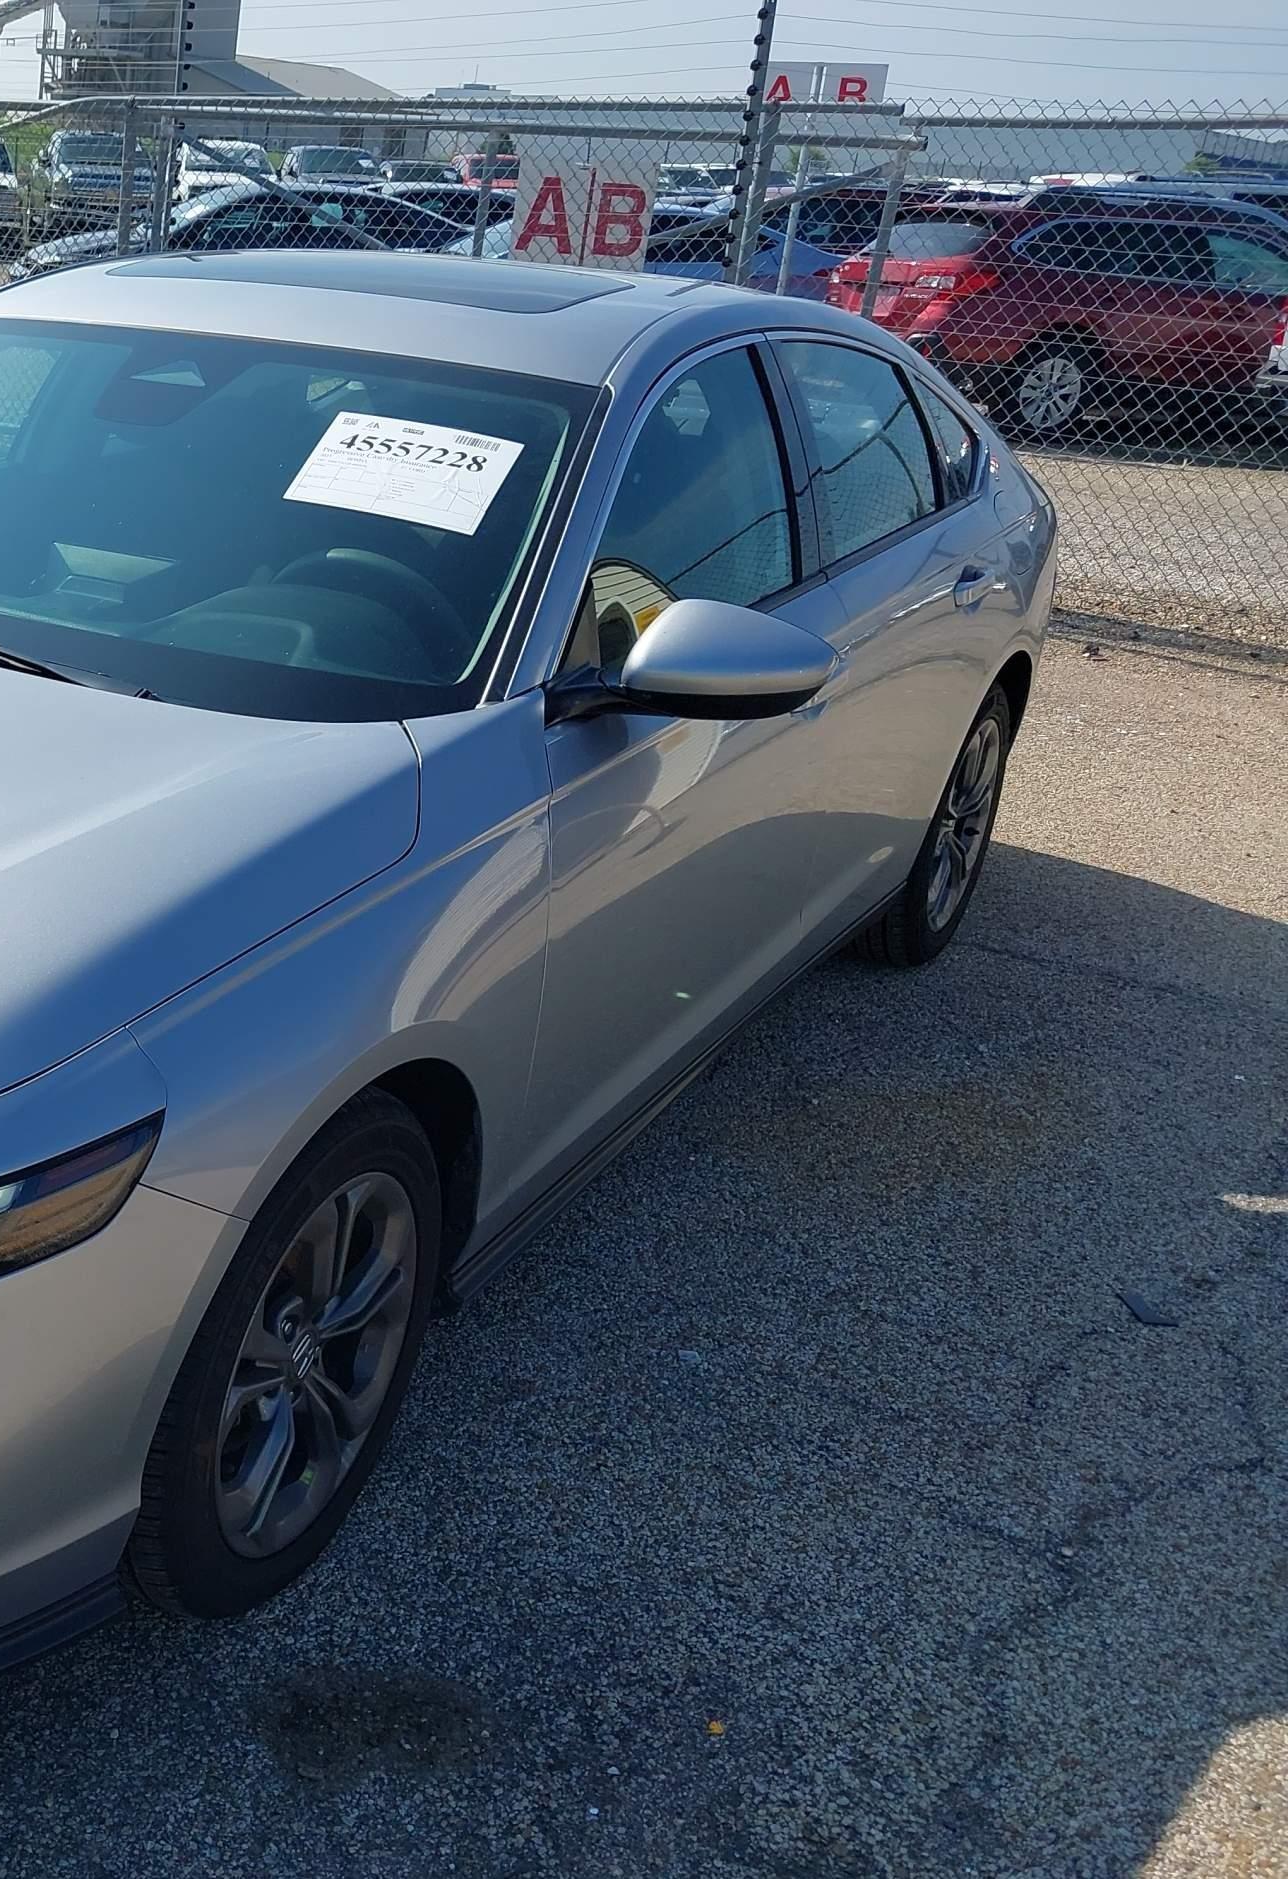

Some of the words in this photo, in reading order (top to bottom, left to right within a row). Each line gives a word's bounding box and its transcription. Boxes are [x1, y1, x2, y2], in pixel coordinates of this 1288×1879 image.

[514, 176, 571, 255] A
[592, 182, 646, 257] B
[339, 433, 487, 473] 45557228
